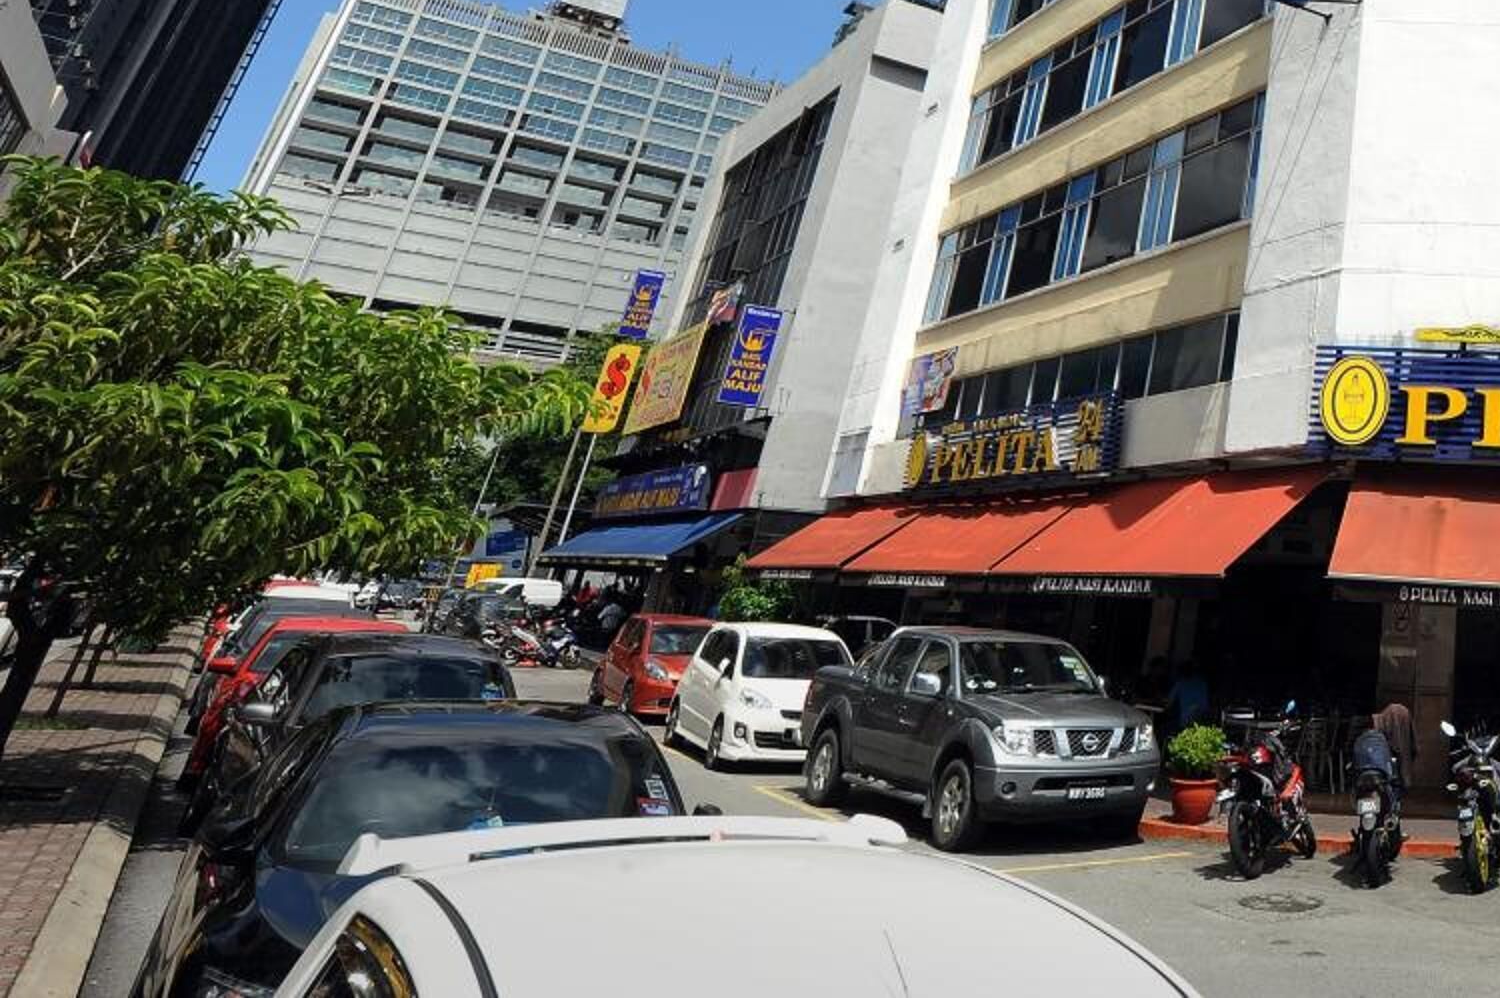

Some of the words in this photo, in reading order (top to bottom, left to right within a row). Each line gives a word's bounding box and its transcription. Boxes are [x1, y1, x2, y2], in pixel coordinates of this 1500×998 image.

[730, 369, 761, 381] ALIF
[931, 428, 1056, 483] PELITA
[1411, 586, 1457, 604] PELITA
[1463, 589, 1493, 606] NASI
